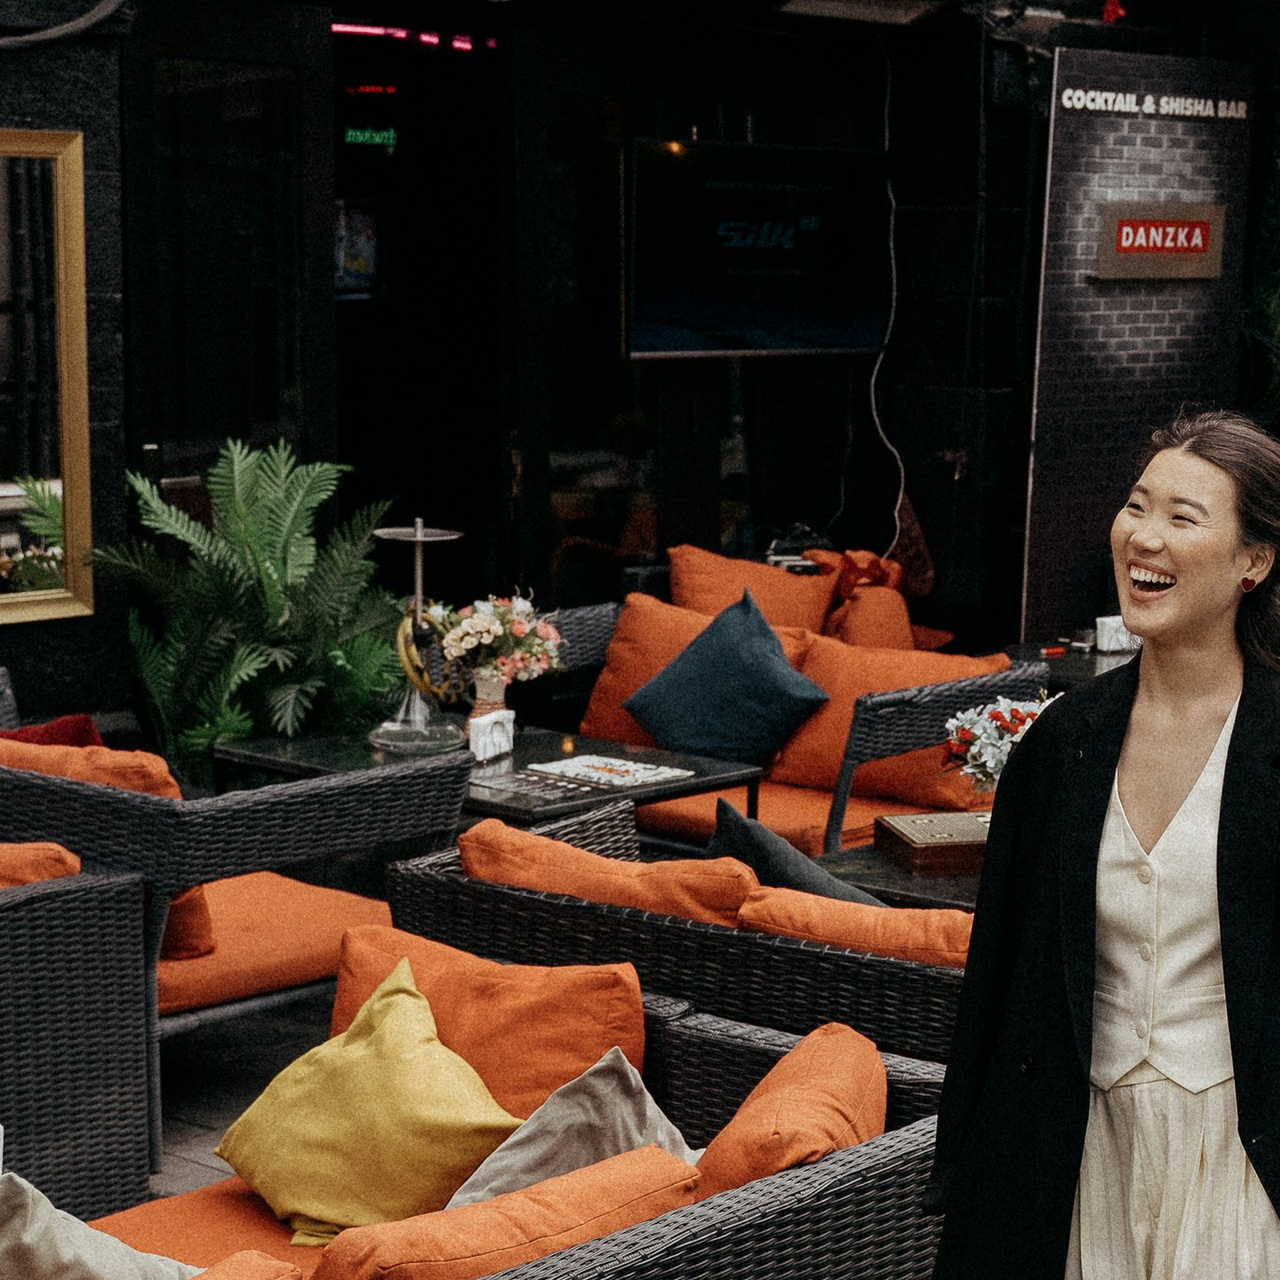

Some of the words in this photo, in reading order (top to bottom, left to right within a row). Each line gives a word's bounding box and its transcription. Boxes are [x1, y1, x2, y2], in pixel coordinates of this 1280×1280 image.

[1062, 89, 1139, 113] COCKTAIL
[1143, 95, 1155, 114] &
[1159, 97, 1214, 117] SHISHA
[1218, 101, 1247, 119] BAR
[1121, 226, 1203, 248] DANZKA
